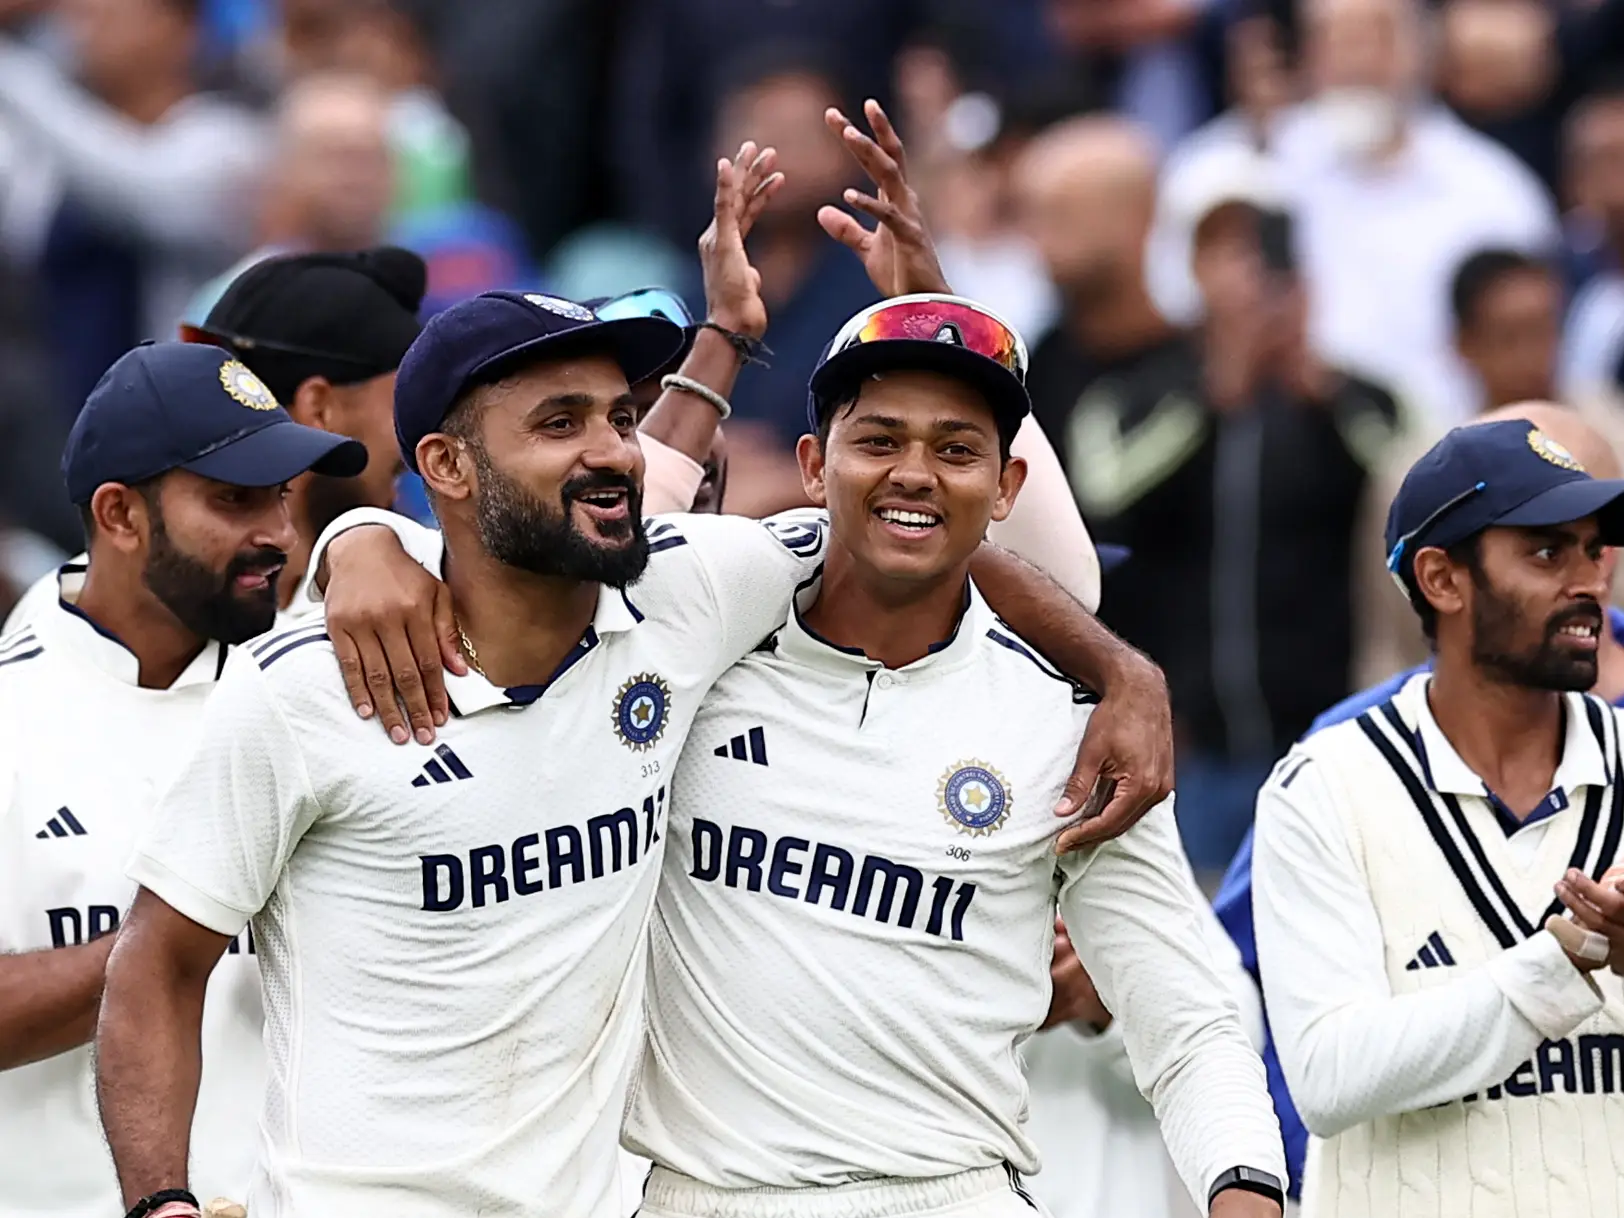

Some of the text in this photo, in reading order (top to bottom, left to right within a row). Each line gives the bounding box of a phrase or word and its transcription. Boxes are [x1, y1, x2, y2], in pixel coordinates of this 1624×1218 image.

[640, 760, 661, 778] 313
[945, 843, 972, 862] 306
[688, 817, 977, 942] DREAM11
